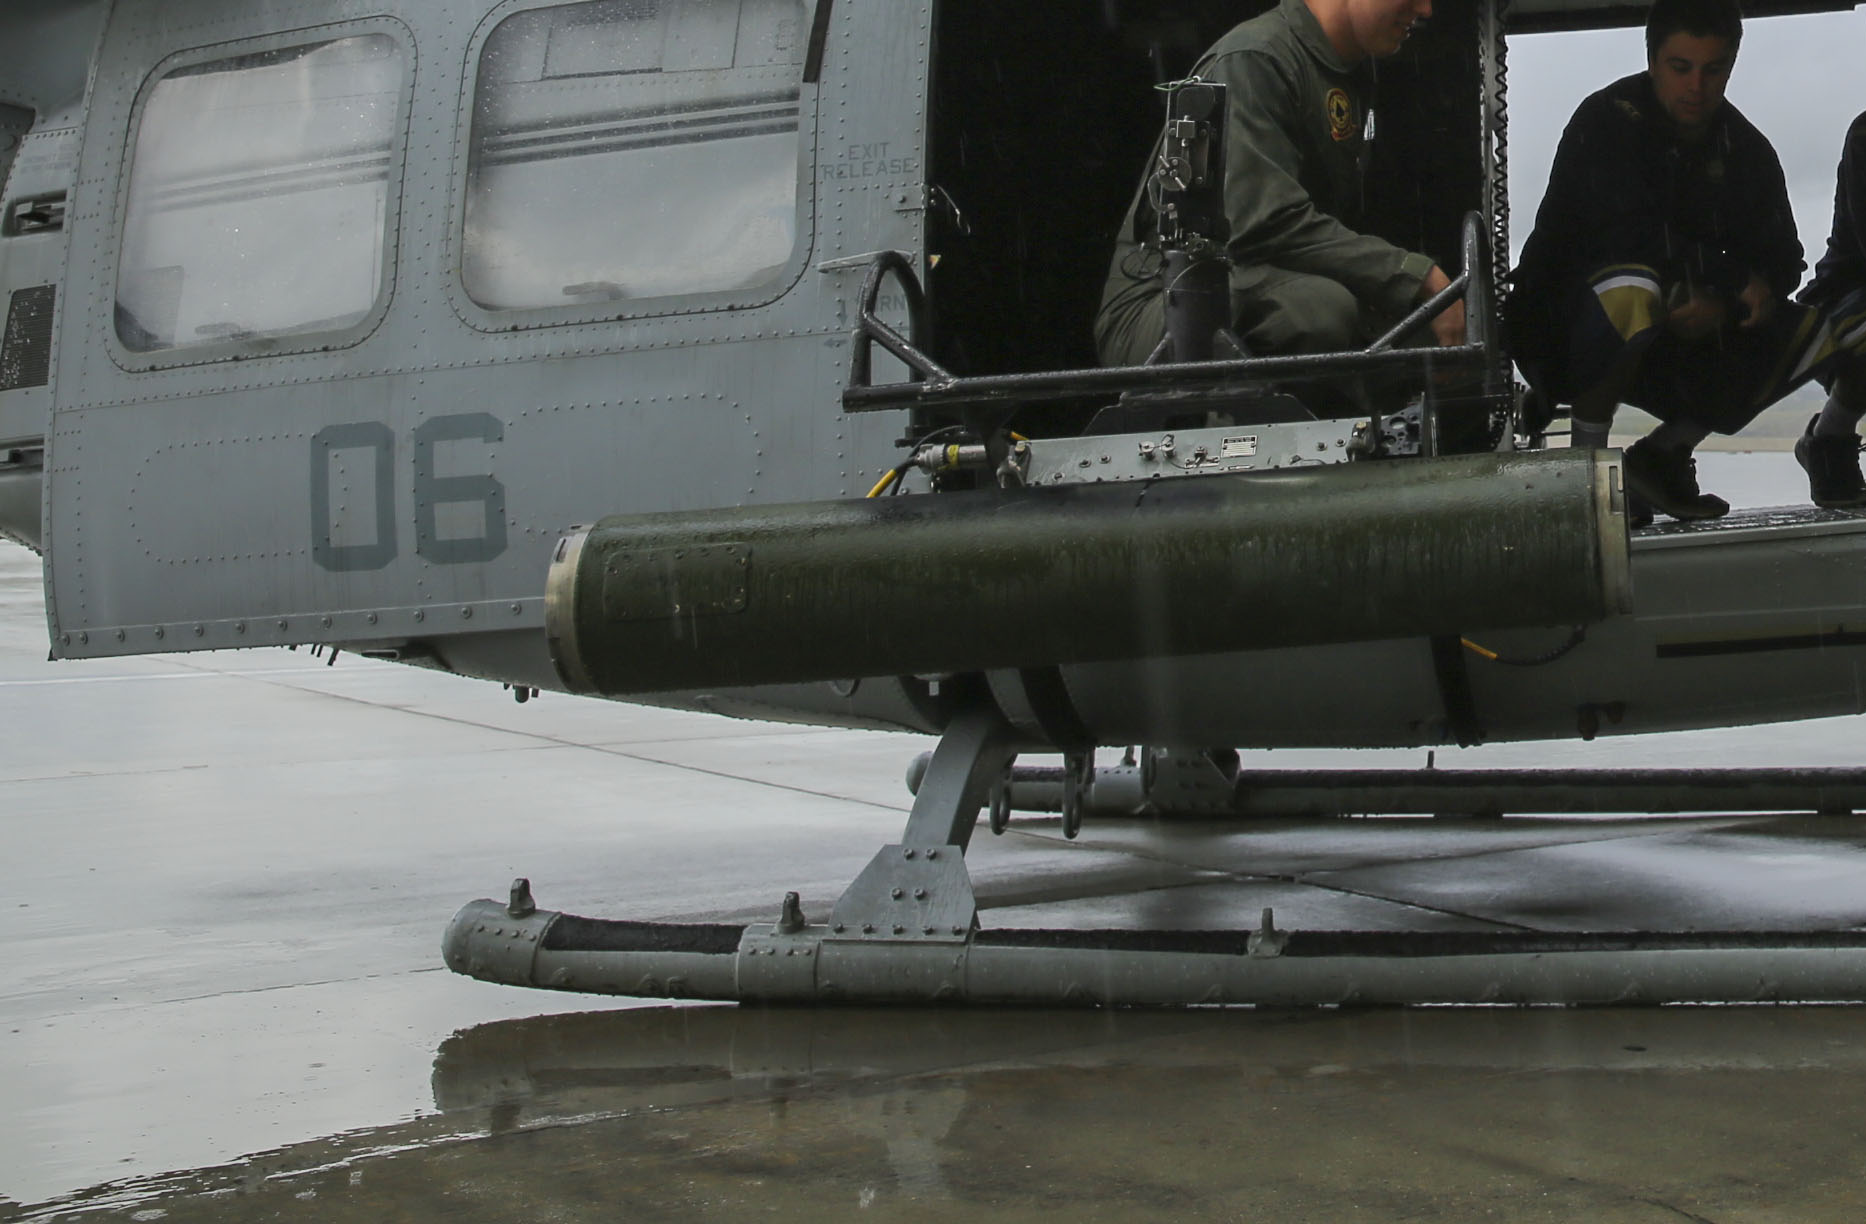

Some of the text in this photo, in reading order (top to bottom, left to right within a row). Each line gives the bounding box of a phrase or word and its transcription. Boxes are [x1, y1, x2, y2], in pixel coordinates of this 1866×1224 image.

[849, 142, 889, 161] EXIT
[823, 158, 915, 179] RELEASE
[310, 412, 508, 572] 06
